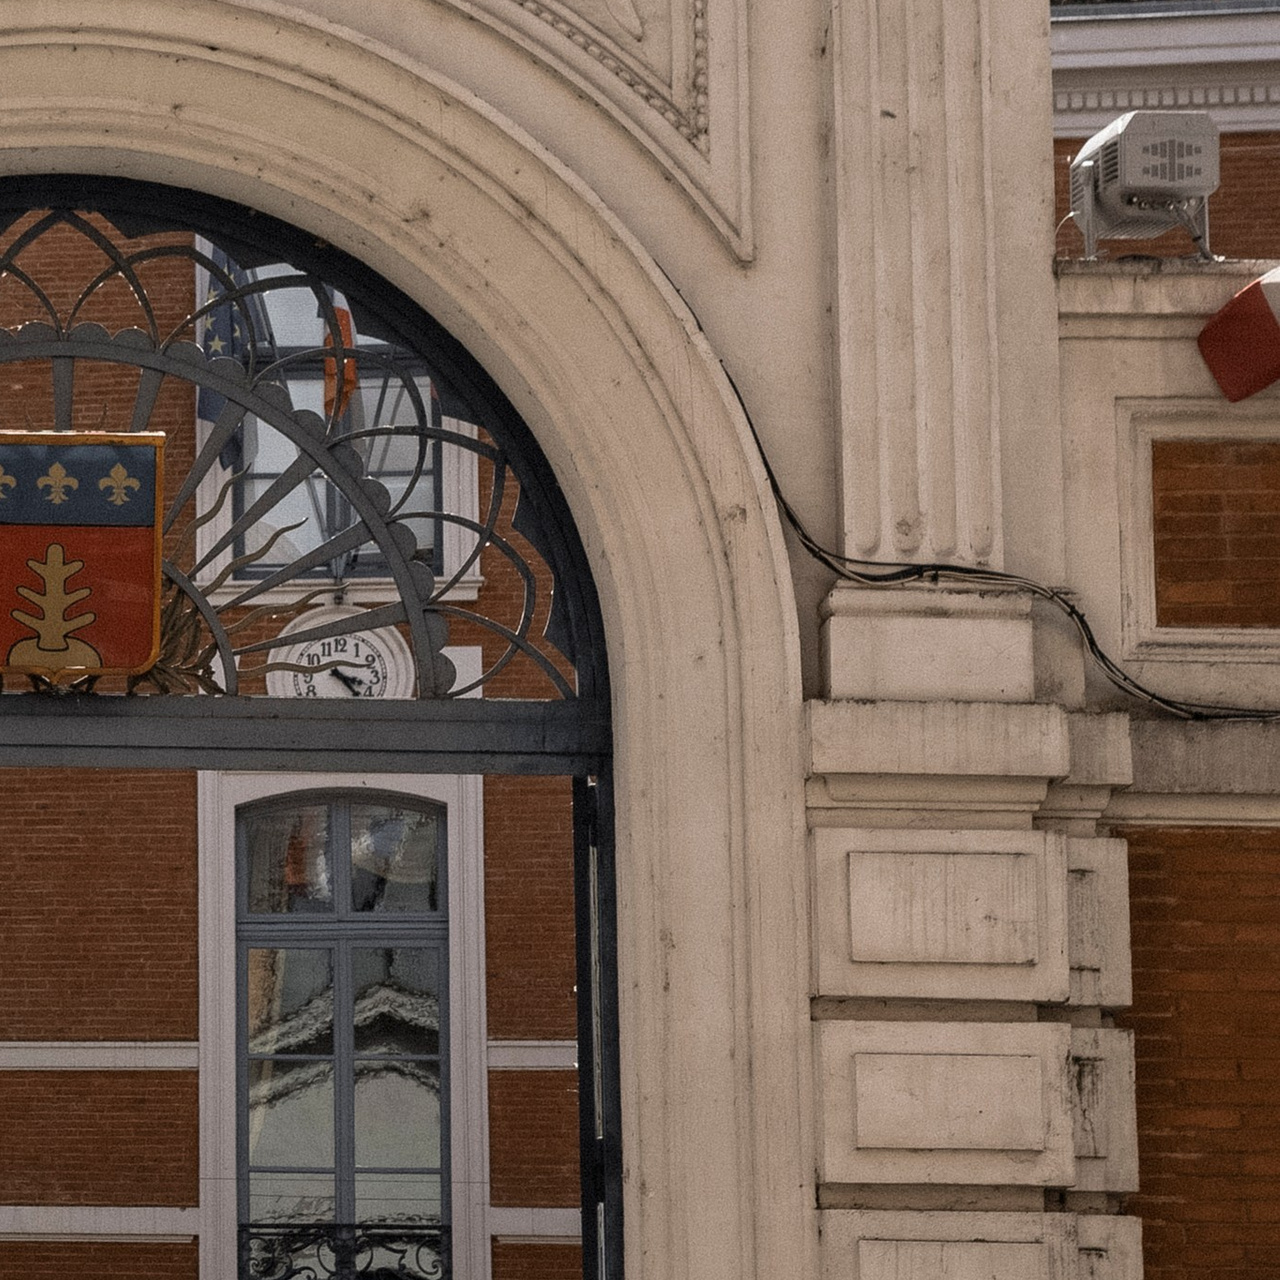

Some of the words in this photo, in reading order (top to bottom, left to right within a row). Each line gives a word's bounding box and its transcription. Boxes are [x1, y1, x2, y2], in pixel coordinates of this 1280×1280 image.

[320, 641, 332, 657] 11
[333, 637, 348, 653] 12
[353, 642, 360, 658] 1
[306, 652, 321, 666] 10
[369, 669, 380, 685] 3
[363, 685, 375, 697] 4
